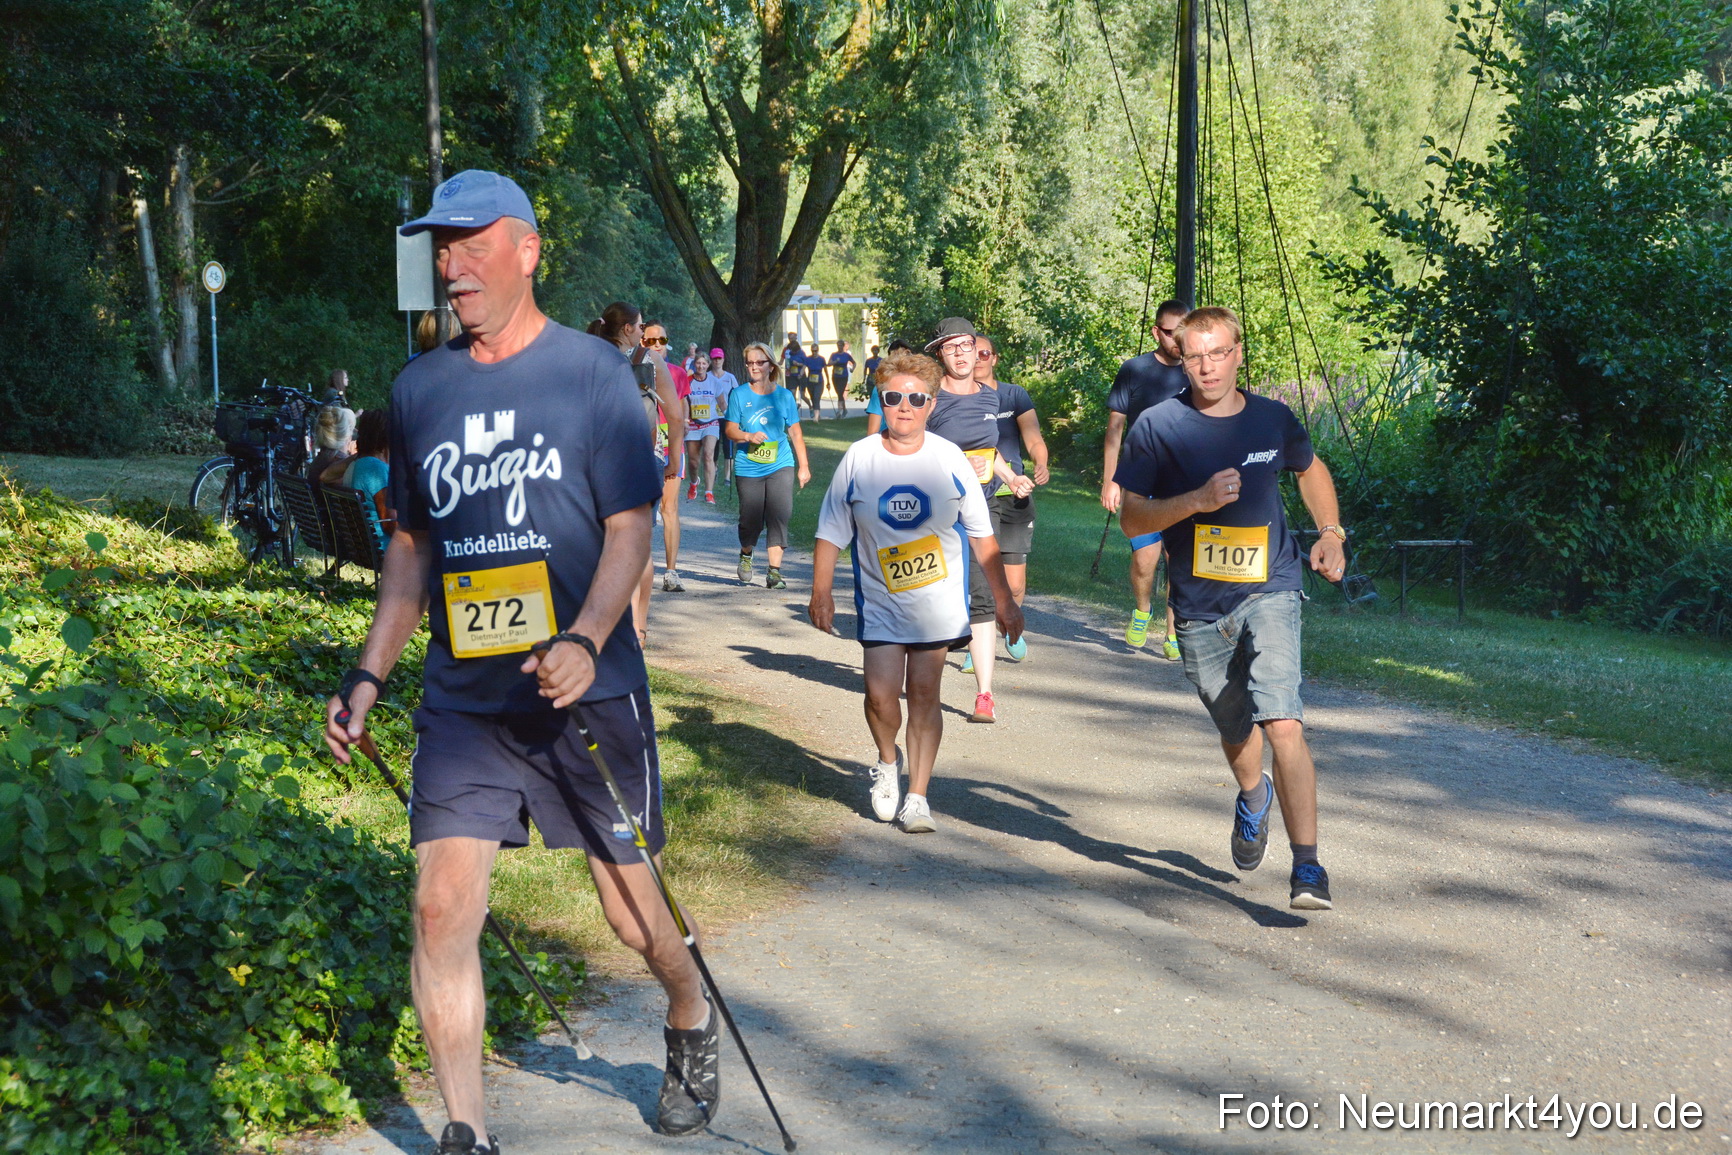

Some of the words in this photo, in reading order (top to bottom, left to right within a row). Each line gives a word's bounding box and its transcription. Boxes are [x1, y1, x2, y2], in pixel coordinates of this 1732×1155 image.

[423, 432, 562, 527] Burgis
[890, 500, 918, 511] TÜV
[889, 552, 938, 580] 2022
[1204, 544, 1259, 566] 1107
[465, 597, 527, 632] 272
[471, 632, 507, 642] Dietmayr
[508, 628, 528, 637] Paul
